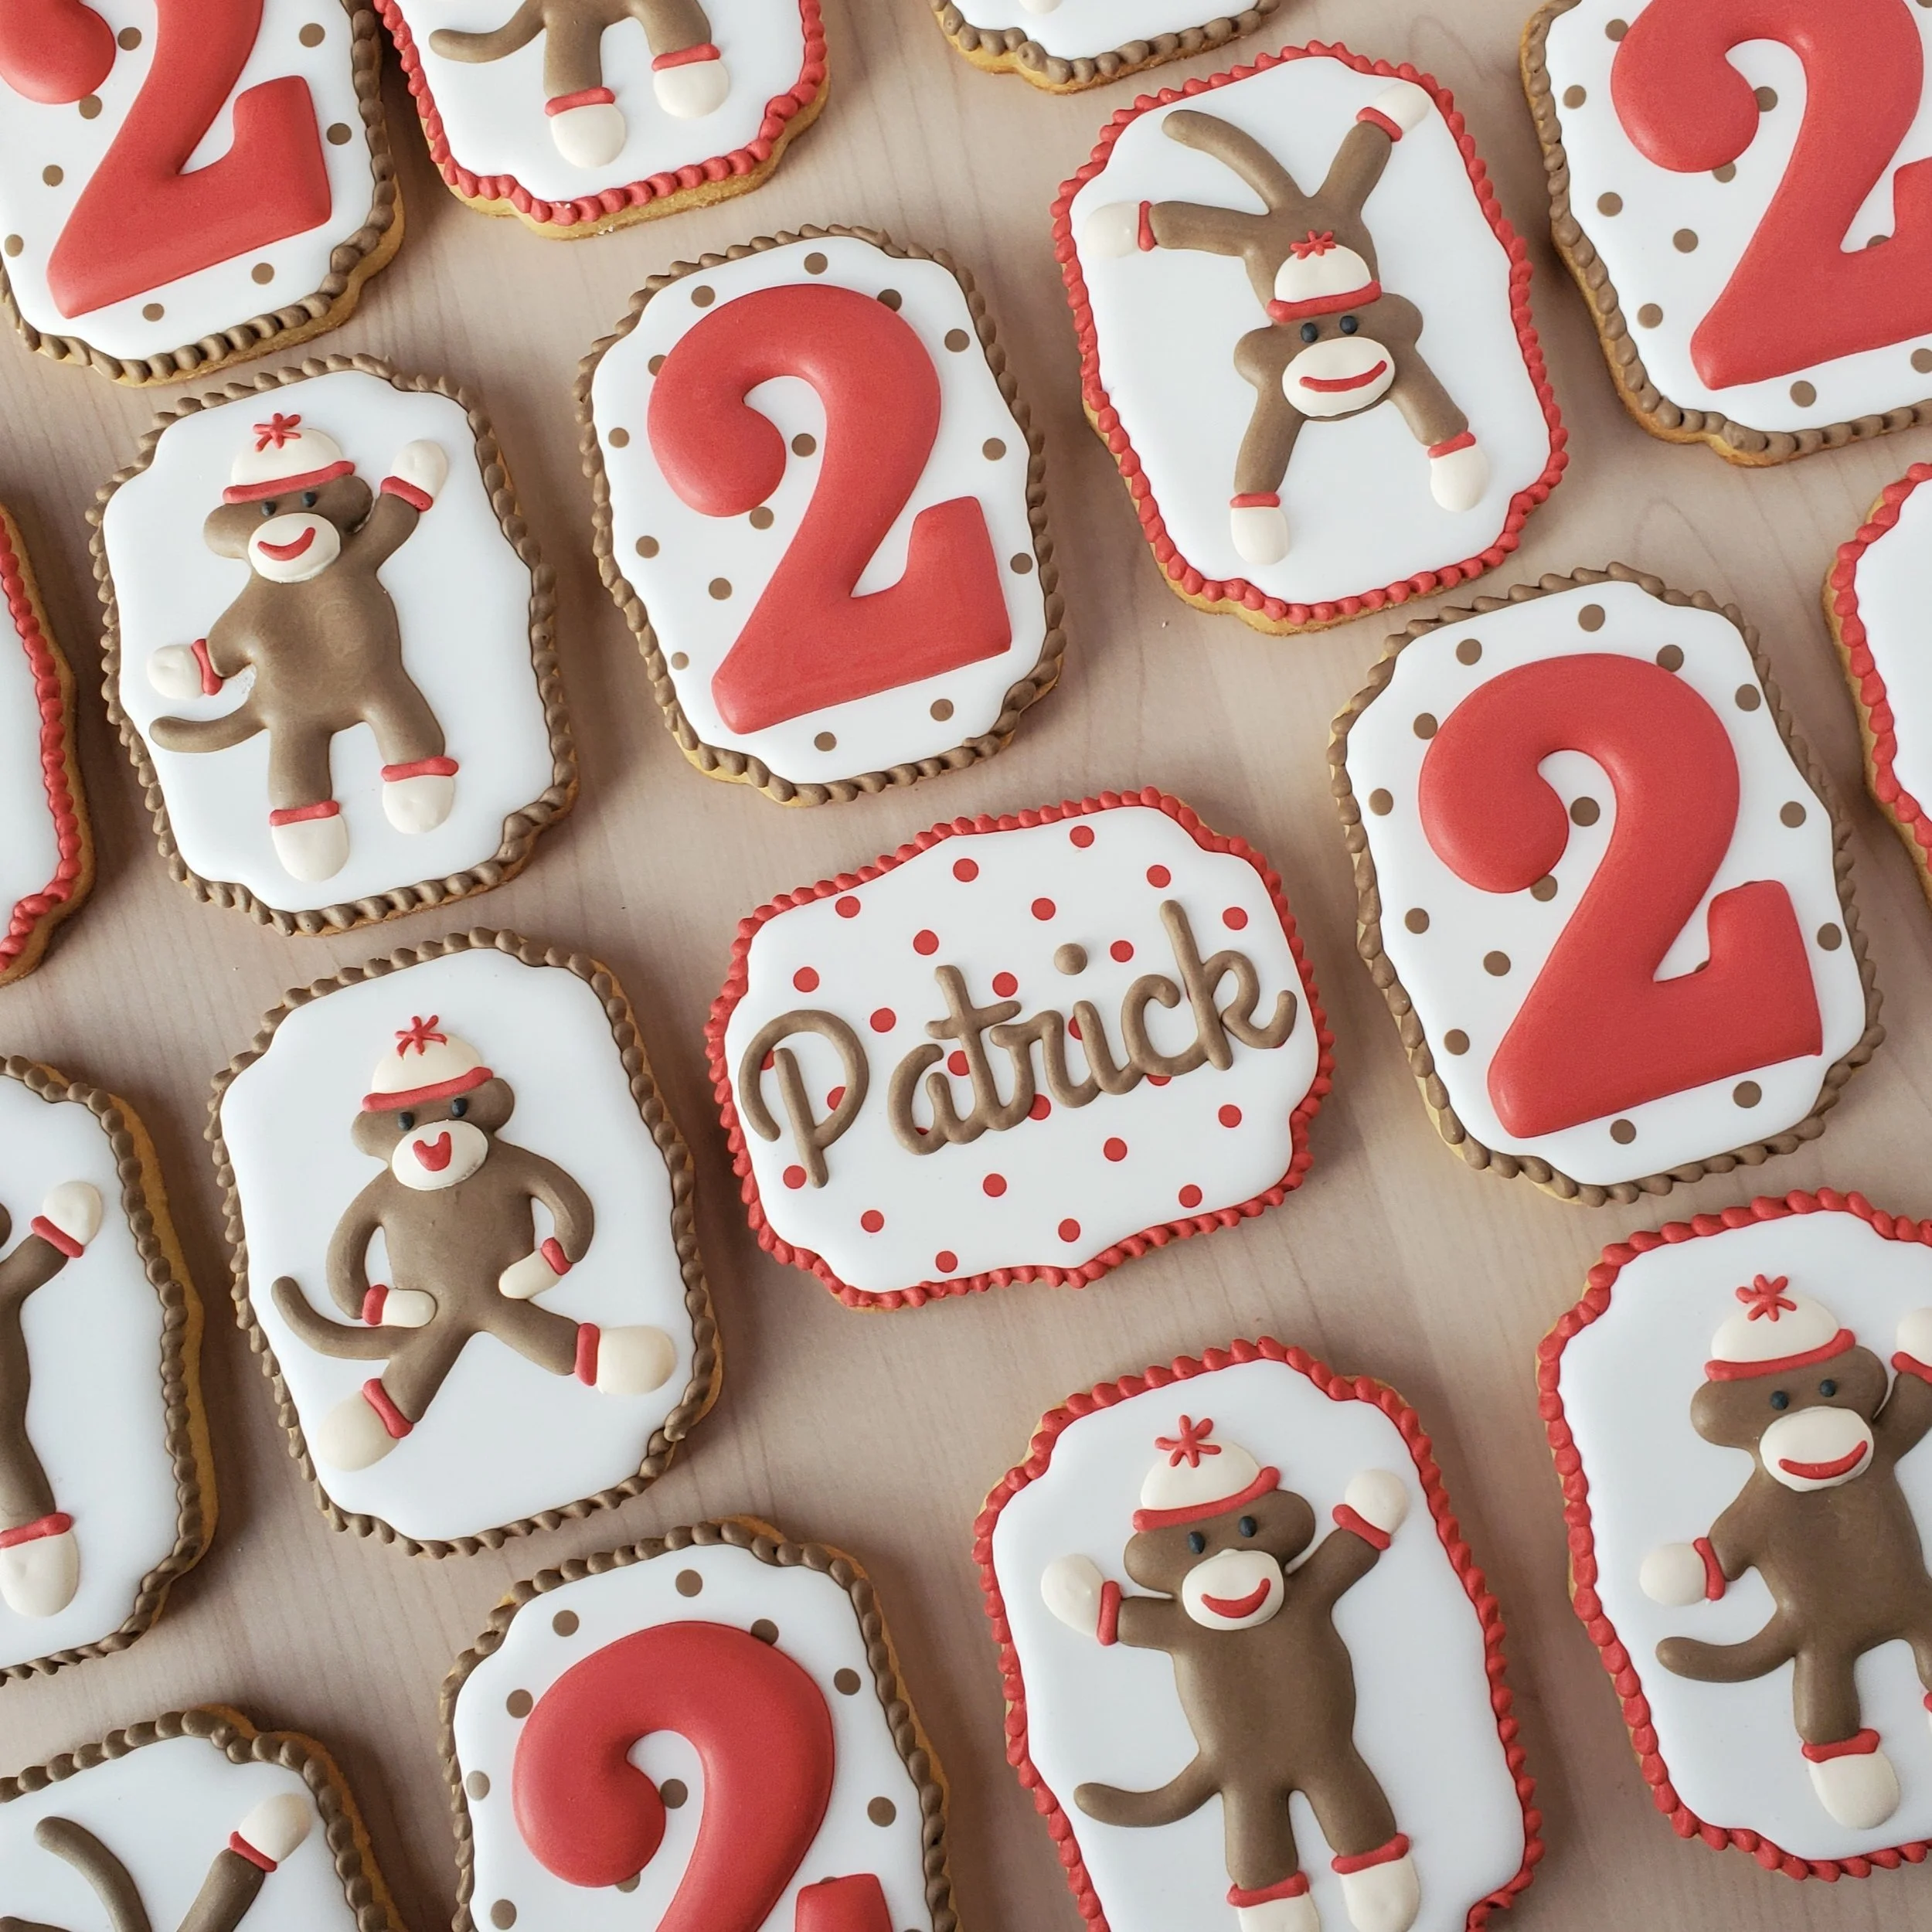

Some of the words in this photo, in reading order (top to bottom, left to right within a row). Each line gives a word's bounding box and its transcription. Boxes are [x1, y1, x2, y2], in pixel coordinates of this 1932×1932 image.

[0, 0, 332, 318] 2
[1611, 0, 1932, 390] 2
[649, 284, 1012, 734] 2
[739, 900, 1298, 1188] Patrick
[1419, 654, 1823, 1139] 2
[512, 1621, 893, 1932] 2
